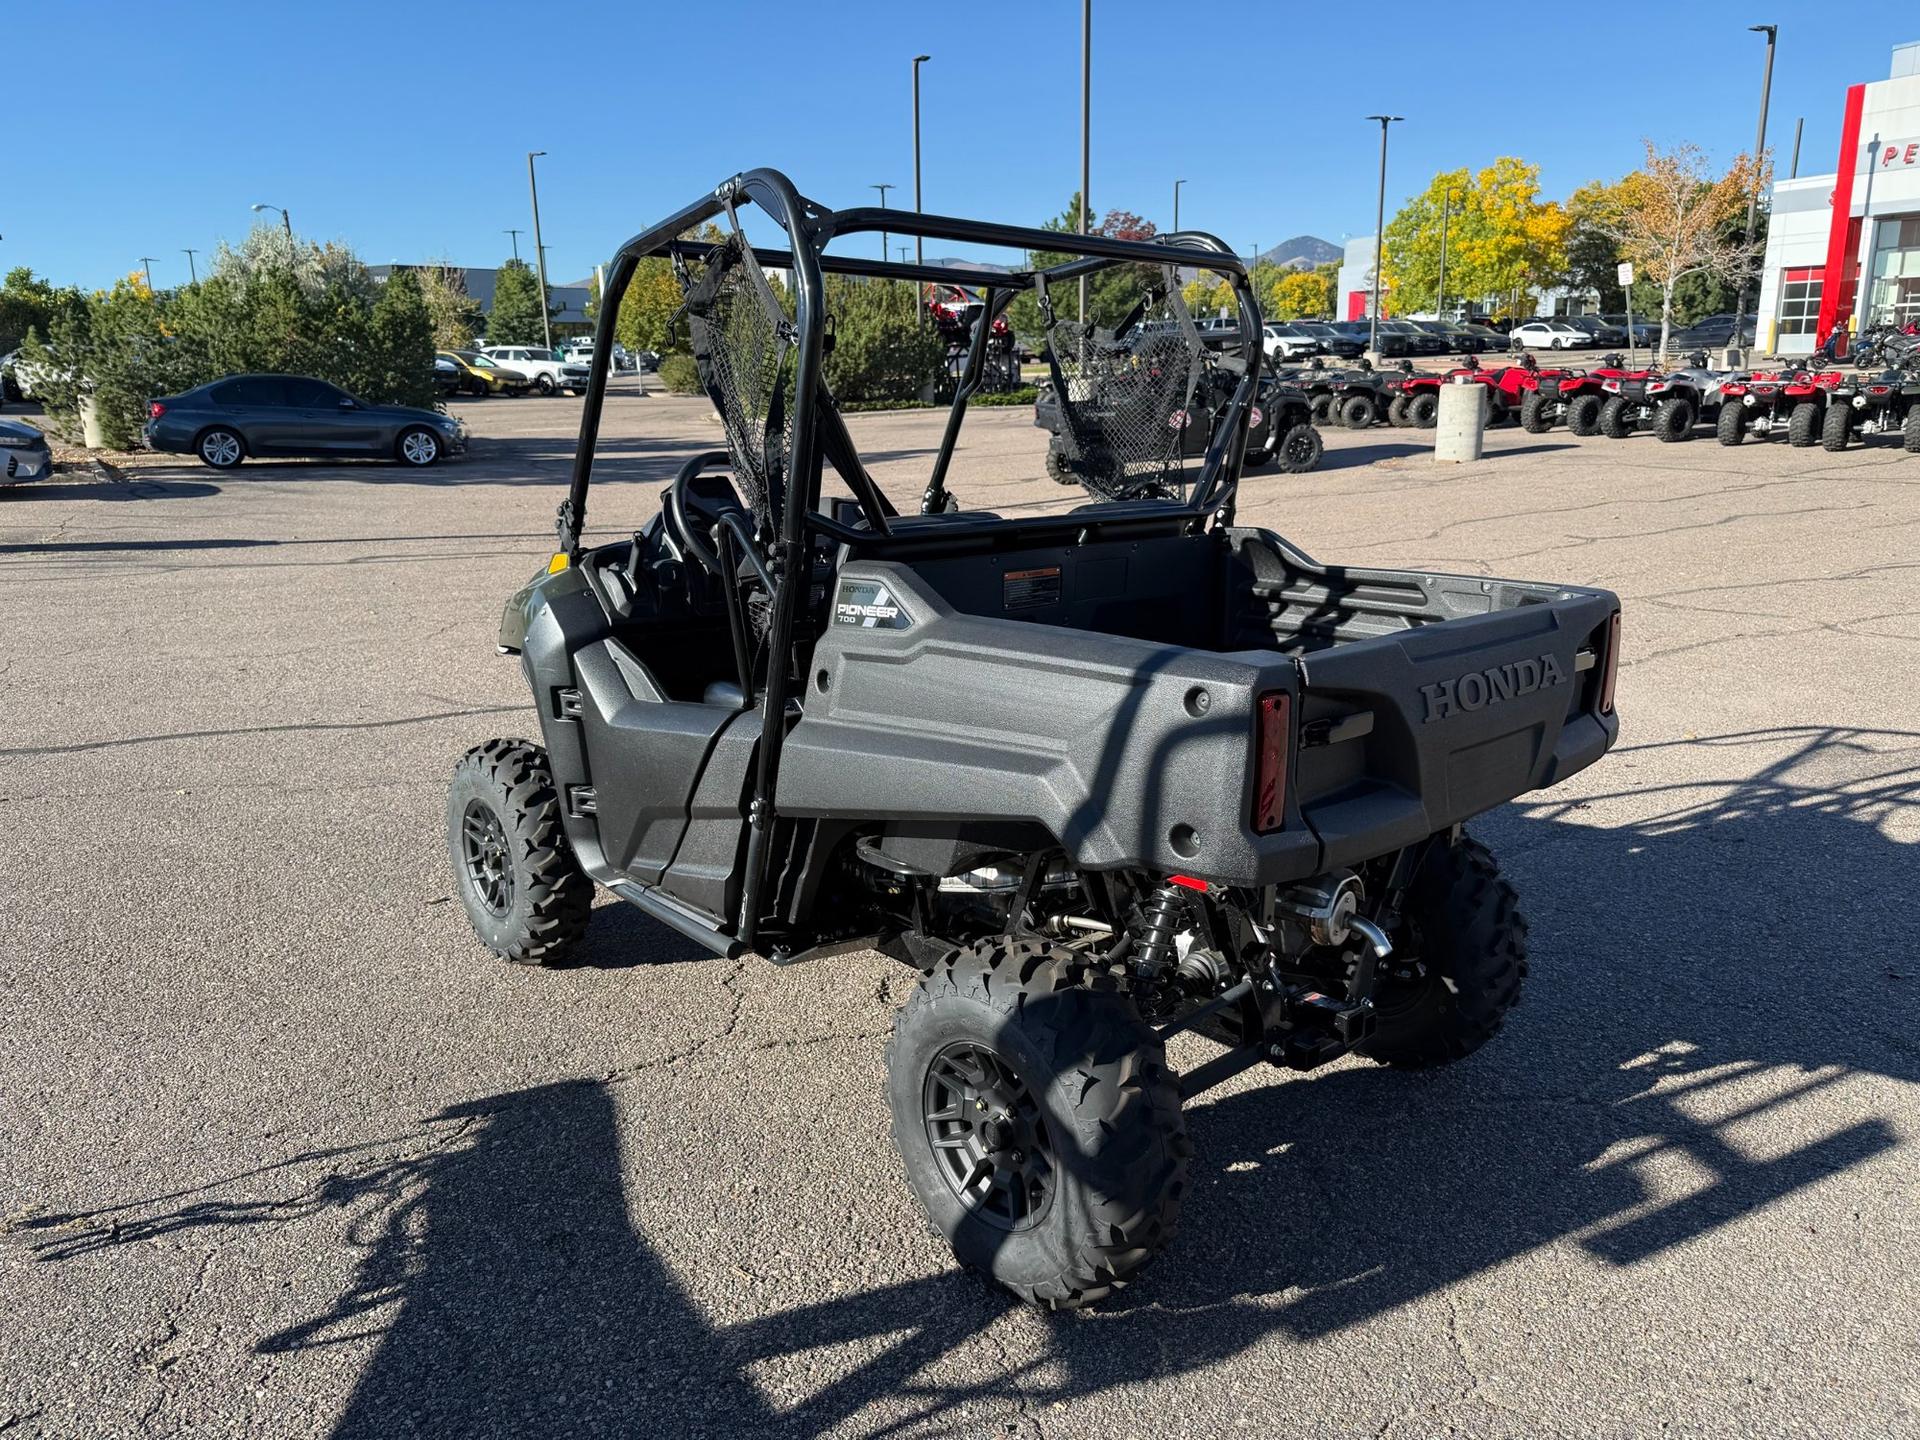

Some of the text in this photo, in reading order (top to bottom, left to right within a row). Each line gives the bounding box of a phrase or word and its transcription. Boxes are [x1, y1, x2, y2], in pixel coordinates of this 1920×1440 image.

[1882, 143, 1920, 167] PE
[842, 585, 875, 593] HONDA
[837, 603, 899, 619] PIONEER
[838, 615, 856, 624] 700
[1421, 653, 1567, 723] HONDA
